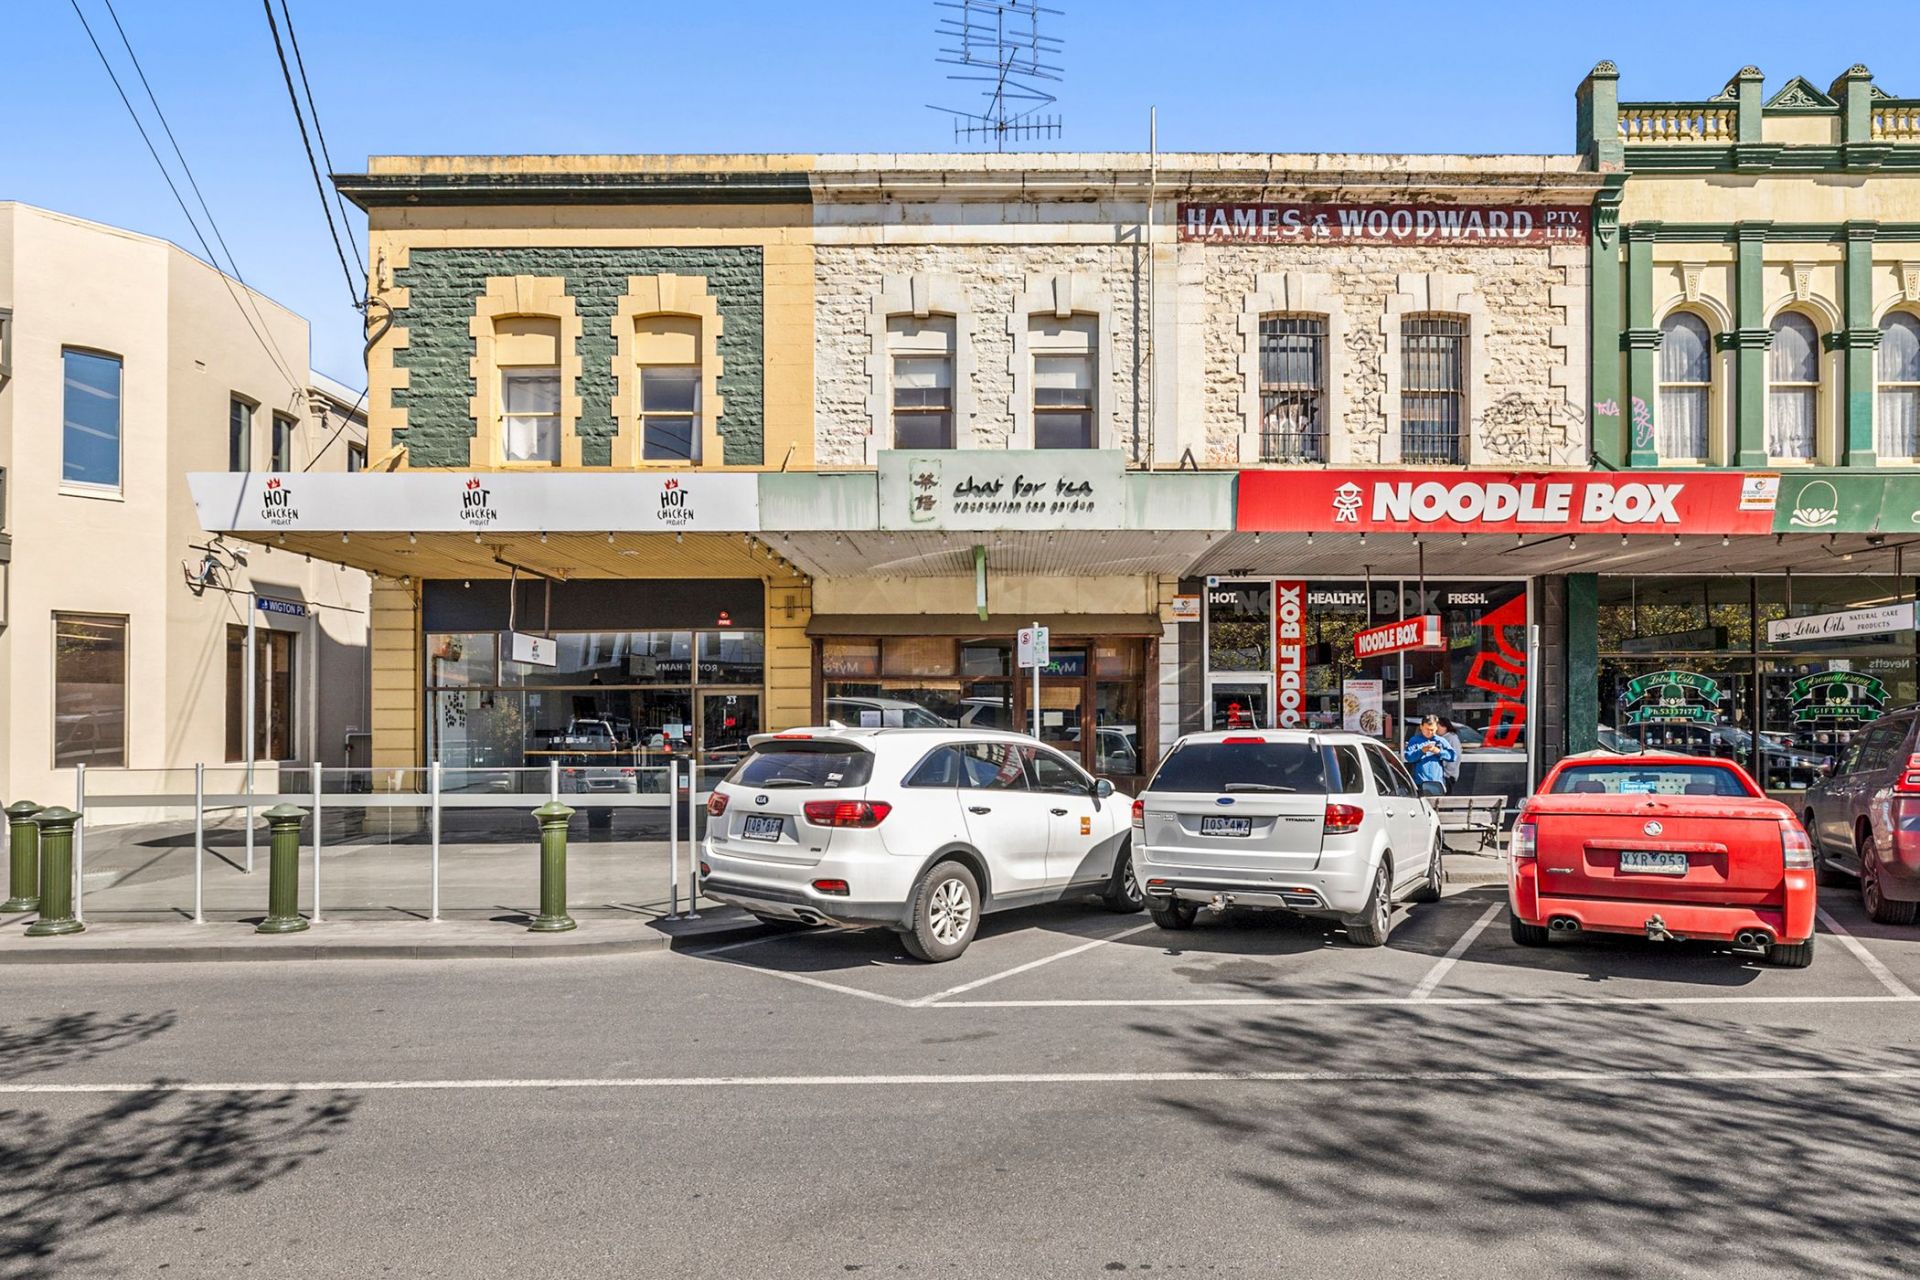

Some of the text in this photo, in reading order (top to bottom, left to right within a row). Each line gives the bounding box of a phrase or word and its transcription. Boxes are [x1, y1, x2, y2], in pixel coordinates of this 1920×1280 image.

[1187, 208, 1532, 238] HAMES & WOODWARD
[1547, 211, 1582, 223] PTY.
[1547, 226, 1582, 238] LTD.
[953, 475, 1094, 499] chat for tea
[264, 489, 291, 508] HOT
[462, 489, 490, 508] HOT
[661, 489, 688, 508] HOT
[1372, 482, 1685, 523] NOODLE BOX
[953, 499, 1095, 515] vegetarian tea garden
[1210, 592, 1238, 603] HOT.
[1307, 592, 1366, 604] HEALTHY.
[1448, 593, 1488, 604] FRESH.
[270, 600, 305, 616] WIGTON PL
[1849, 611, 1877, 621] NATURAL
[1793, 616, 1845, 636] Lotus Oils
[1857, 621, 1890, 630] PRODUCTS
[1359, 623, 1418, 653] NOODLE BOX
[1280, 586, 1300, 728] OODLE BOX
[726, 696, 737, 704] 23
[1623, 853, 1685, 866] XXR 953
